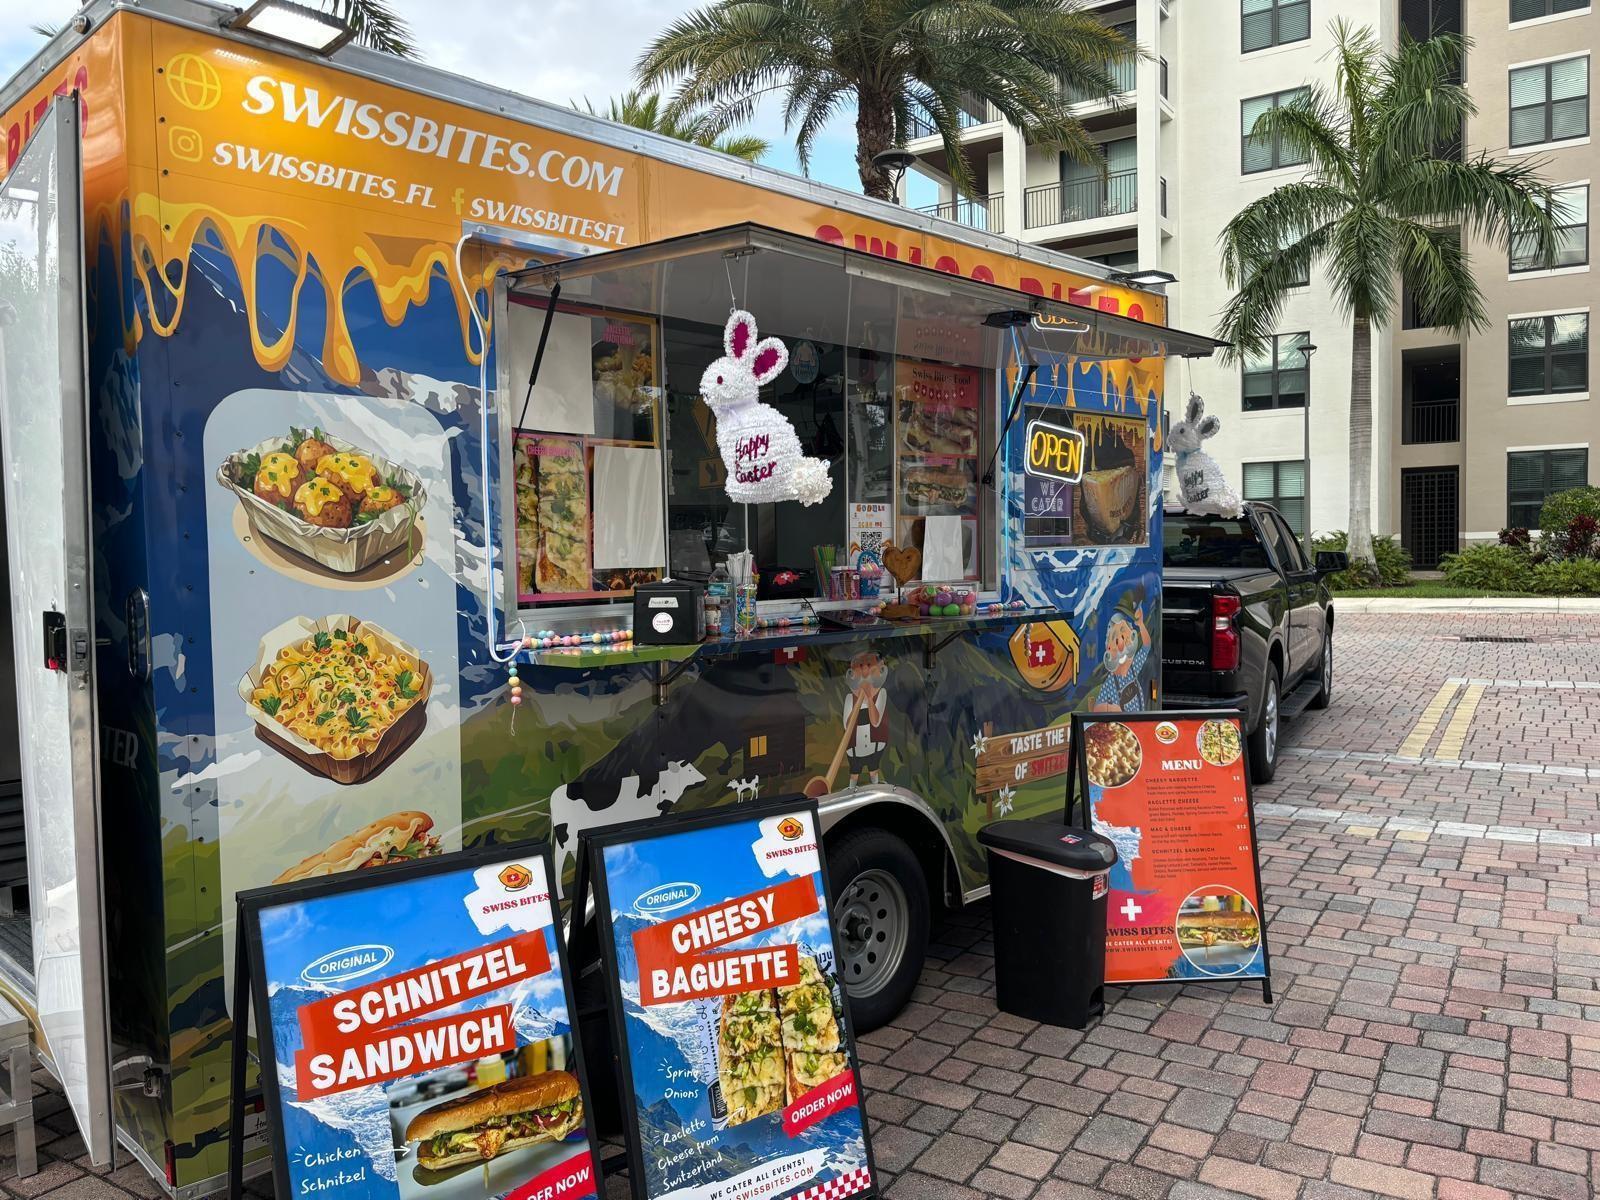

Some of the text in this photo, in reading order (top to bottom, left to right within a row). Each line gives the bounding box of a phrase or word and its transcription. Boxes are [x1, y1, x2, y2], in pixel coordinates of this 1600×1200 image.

[241, 75, 624, 197] SWISSBITES.COM
[212, 142, 436, 208] SWISSBITES_FL
[470, 198, 627, 245] SWISSBITESFL
[1031, 431, 1082, 474] OPEN
[1010, 727, 1065, 755] TASTE THE
[1014, 761, 1028, 780] OF
[1162, 760, 1203, 770] MENU
[765, 843, 819, 860] SWISS BITES
[482, 892, 552, 915] SWISS BITES
[647, 888, 688, 905] ORIGINAL
[671, 893, 775, 954] CHEESY
[1140, 926, 1175, 936] BITES
[319, 952, 377, 974] ORIGINAL
[652, 950, 789, 998] BAGUETTE
[333, 945, 527, 1034] SCHNITZEL
[309, 1014, 505, 1090] SANDWICH
[665, 1065, 699, 1084] Spring
[664, 1087, 699, 1100] Onions
[791, 1083, 852, 1123] ORDER NOW
[662, 1119, 706, 1146] Raclette
[304, 1147, 361, 1167] Chicken
[658, 1134, 719, 1170] Cheese from
[301, 1166, 366, 1195] Schnitzel
[556, 1166, 590, 1195] NOW
[663, 1152, 723, 1192] Switzerland
[710, 1157, 805, 1200] WE CATER ALL EVENTS!
